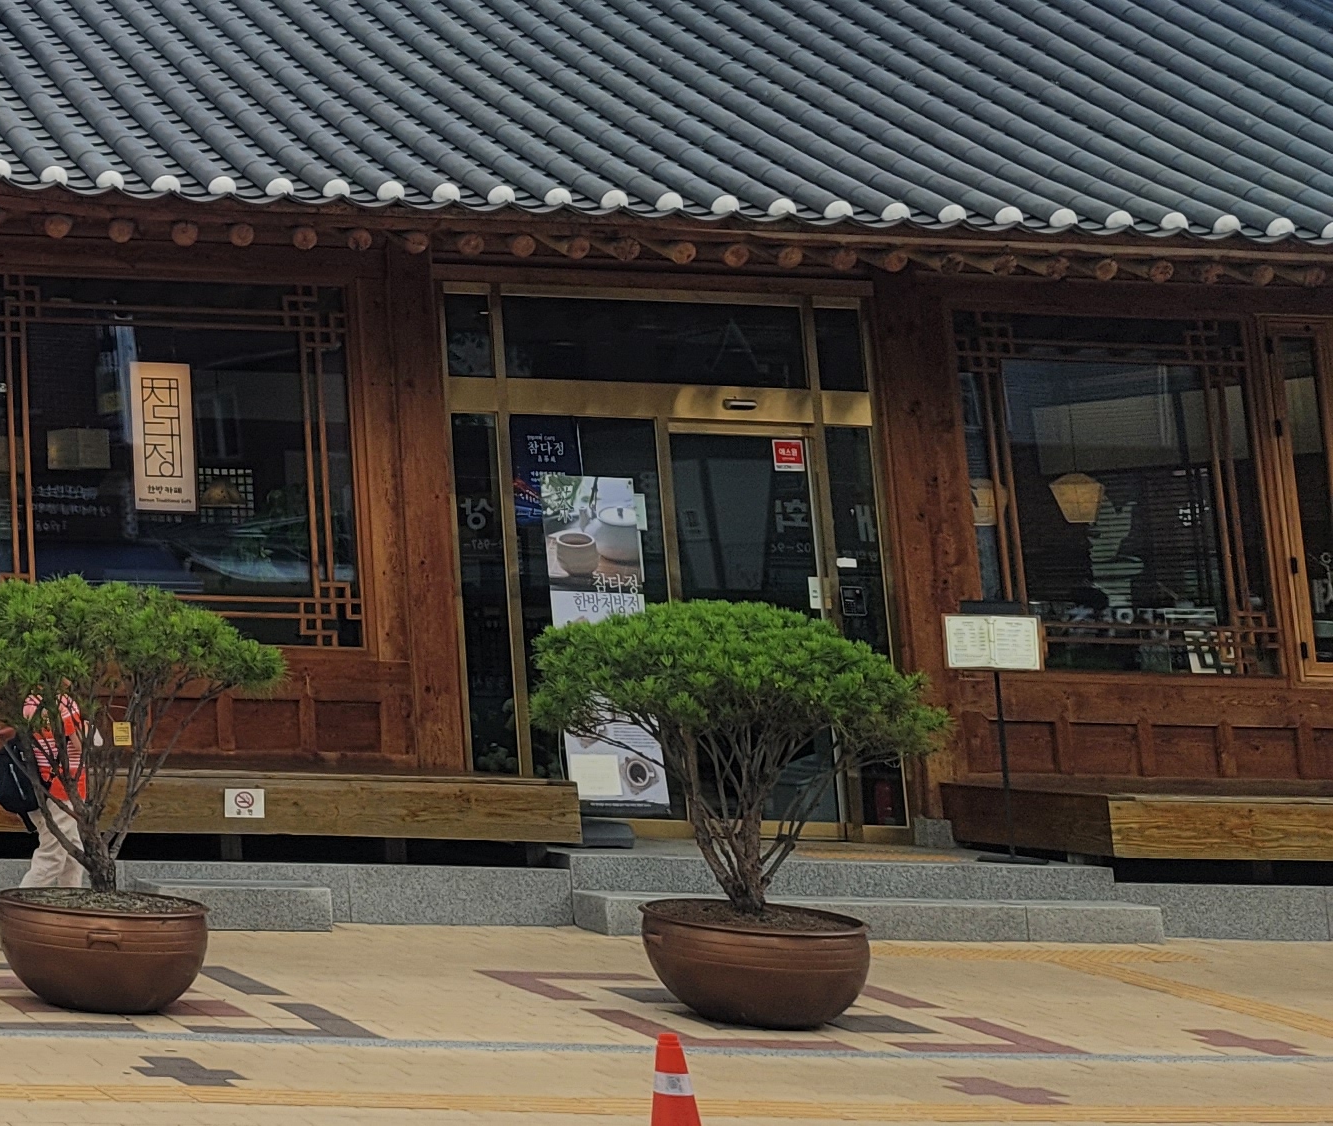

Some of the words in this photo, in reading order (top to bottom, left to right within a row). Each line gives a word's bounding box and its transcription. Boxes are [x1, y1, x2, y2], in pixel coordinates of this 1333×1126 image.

[528, 441, 564, 455] 참다정
[778, 447, 798, 457] 에스원
[593, 573, 640, 594] 참다정
